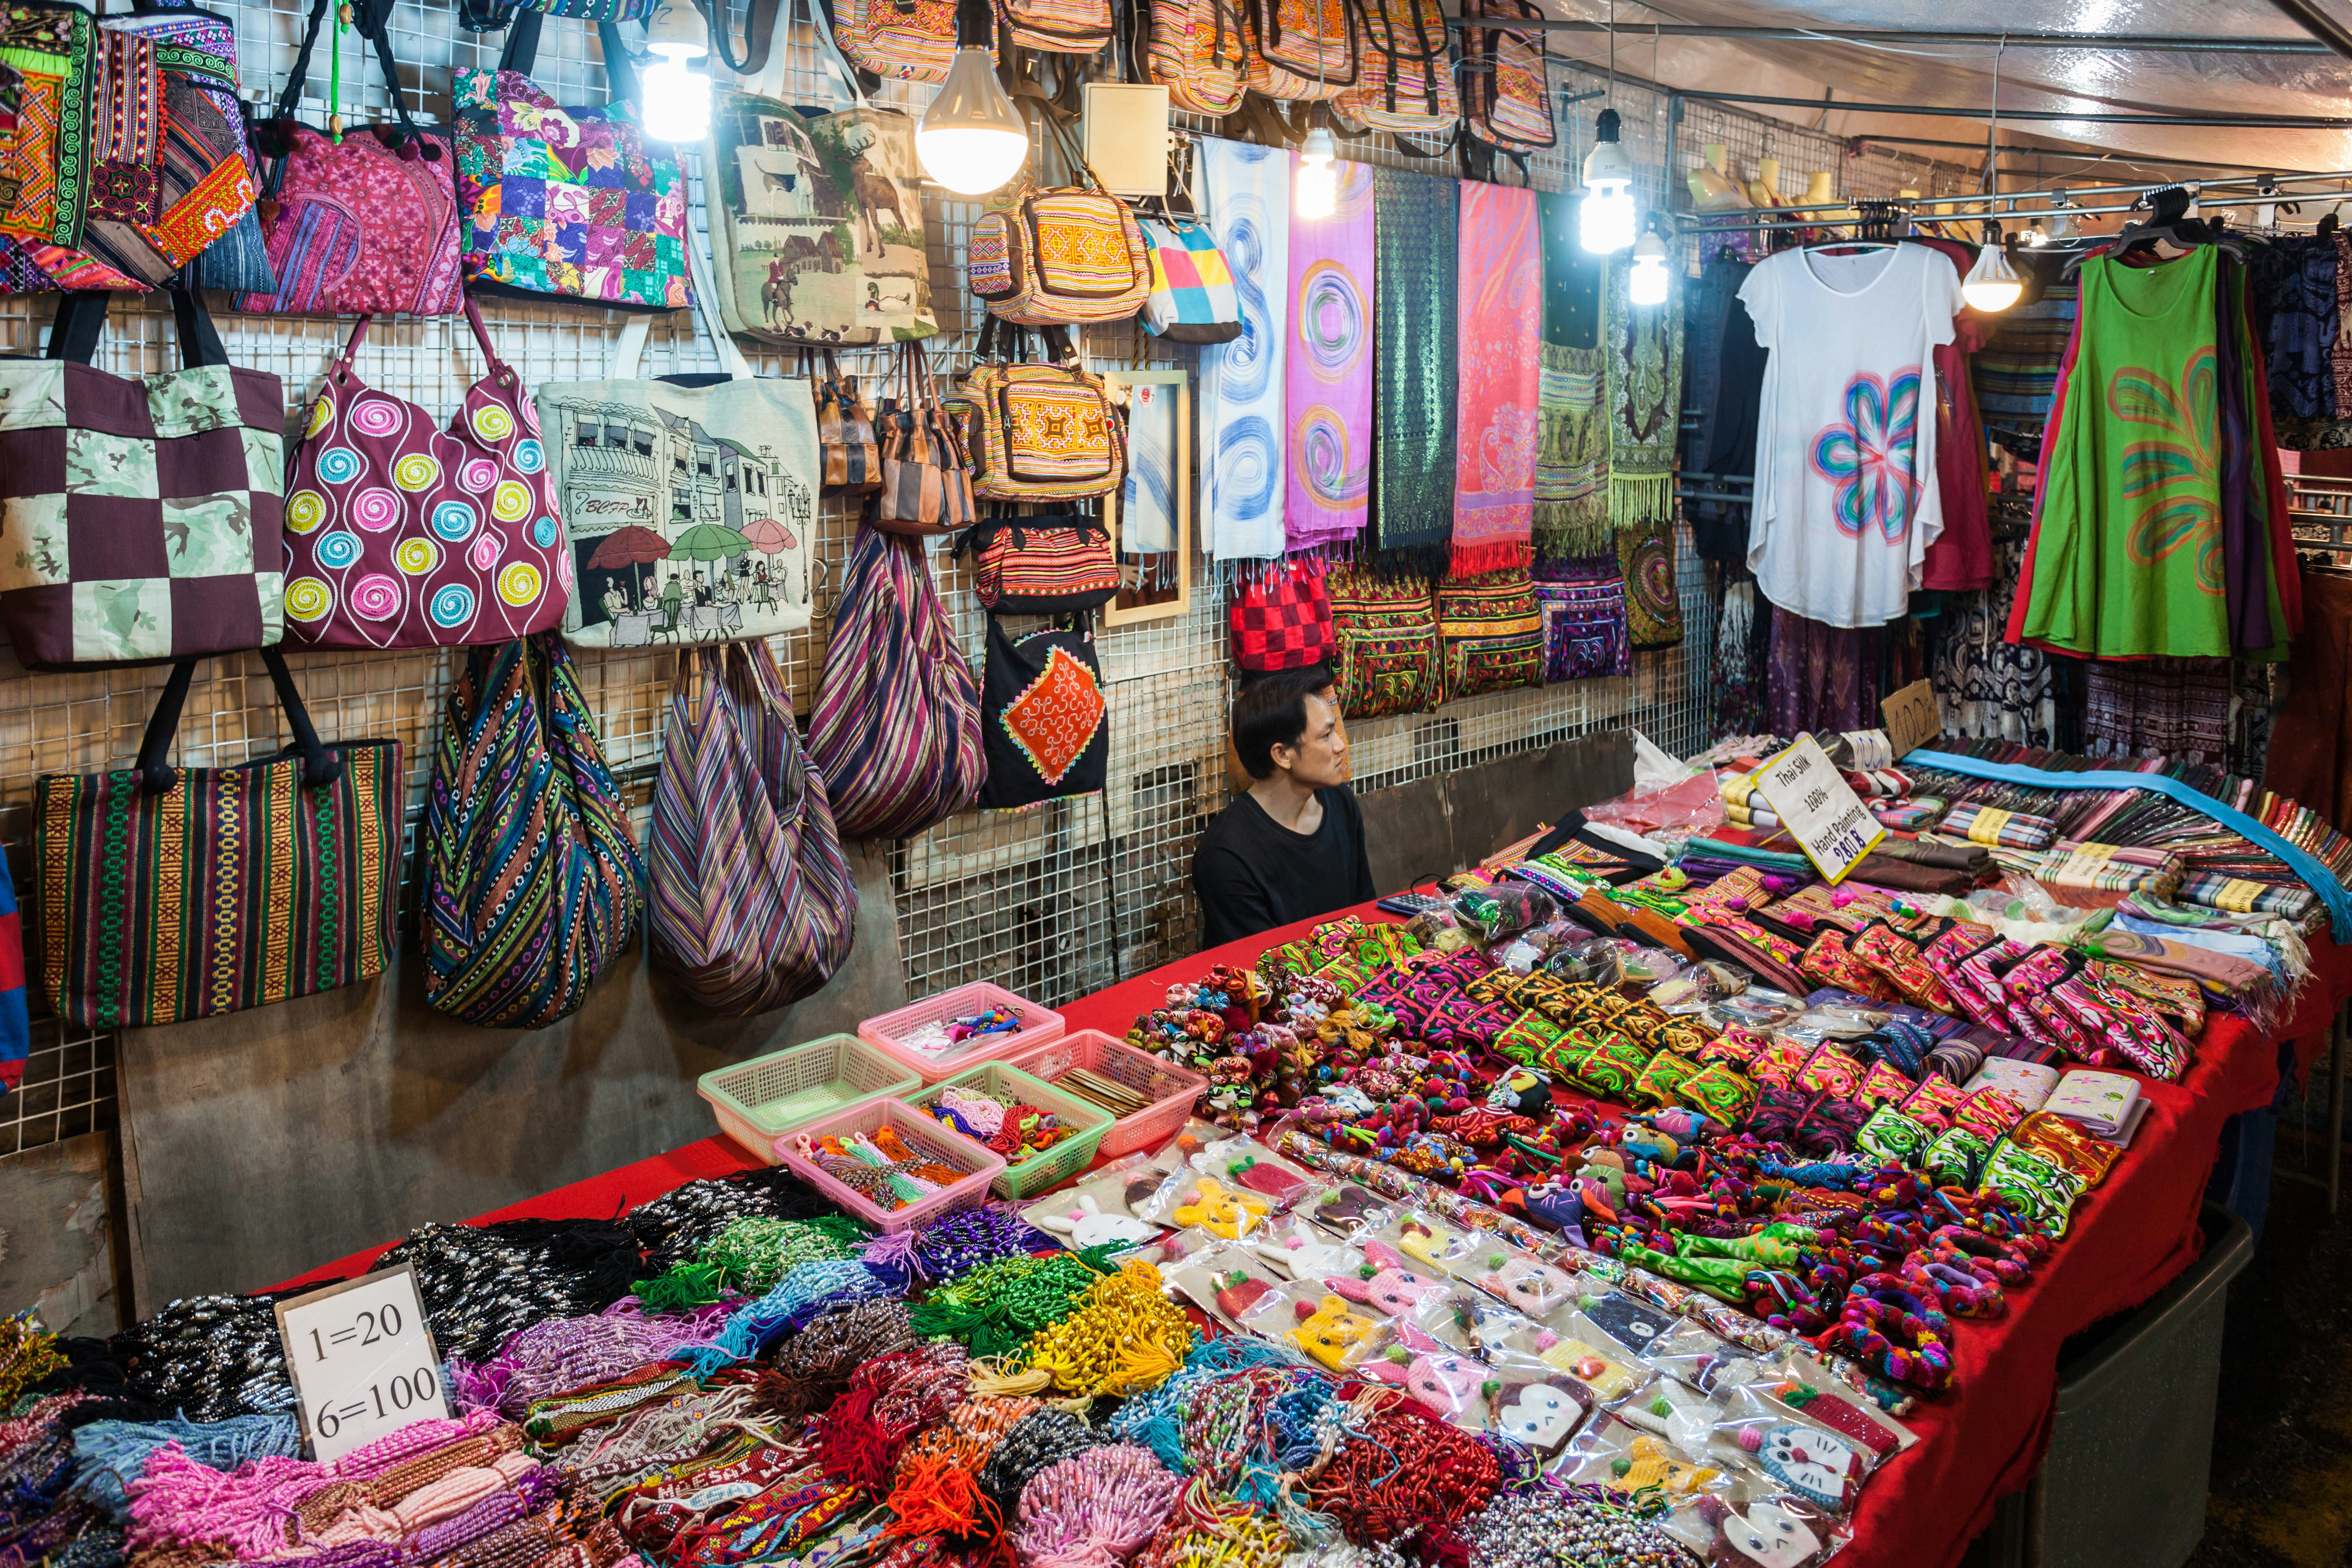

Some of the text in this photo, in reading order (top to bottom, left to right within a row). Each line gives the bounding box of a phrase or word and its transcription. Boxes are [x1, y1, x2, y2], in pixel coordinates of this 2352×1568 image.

[658, 7, 673, 24] 2
[1775, 754, 1812, 787] Thai Silk
[1804, 786, 1828, 813] 100%
[1811, 805, 1867, 856] Hand Painting
[309, 1303, 402, 1362] 1=20
[317, 1367, 436, 1438] 6=100
